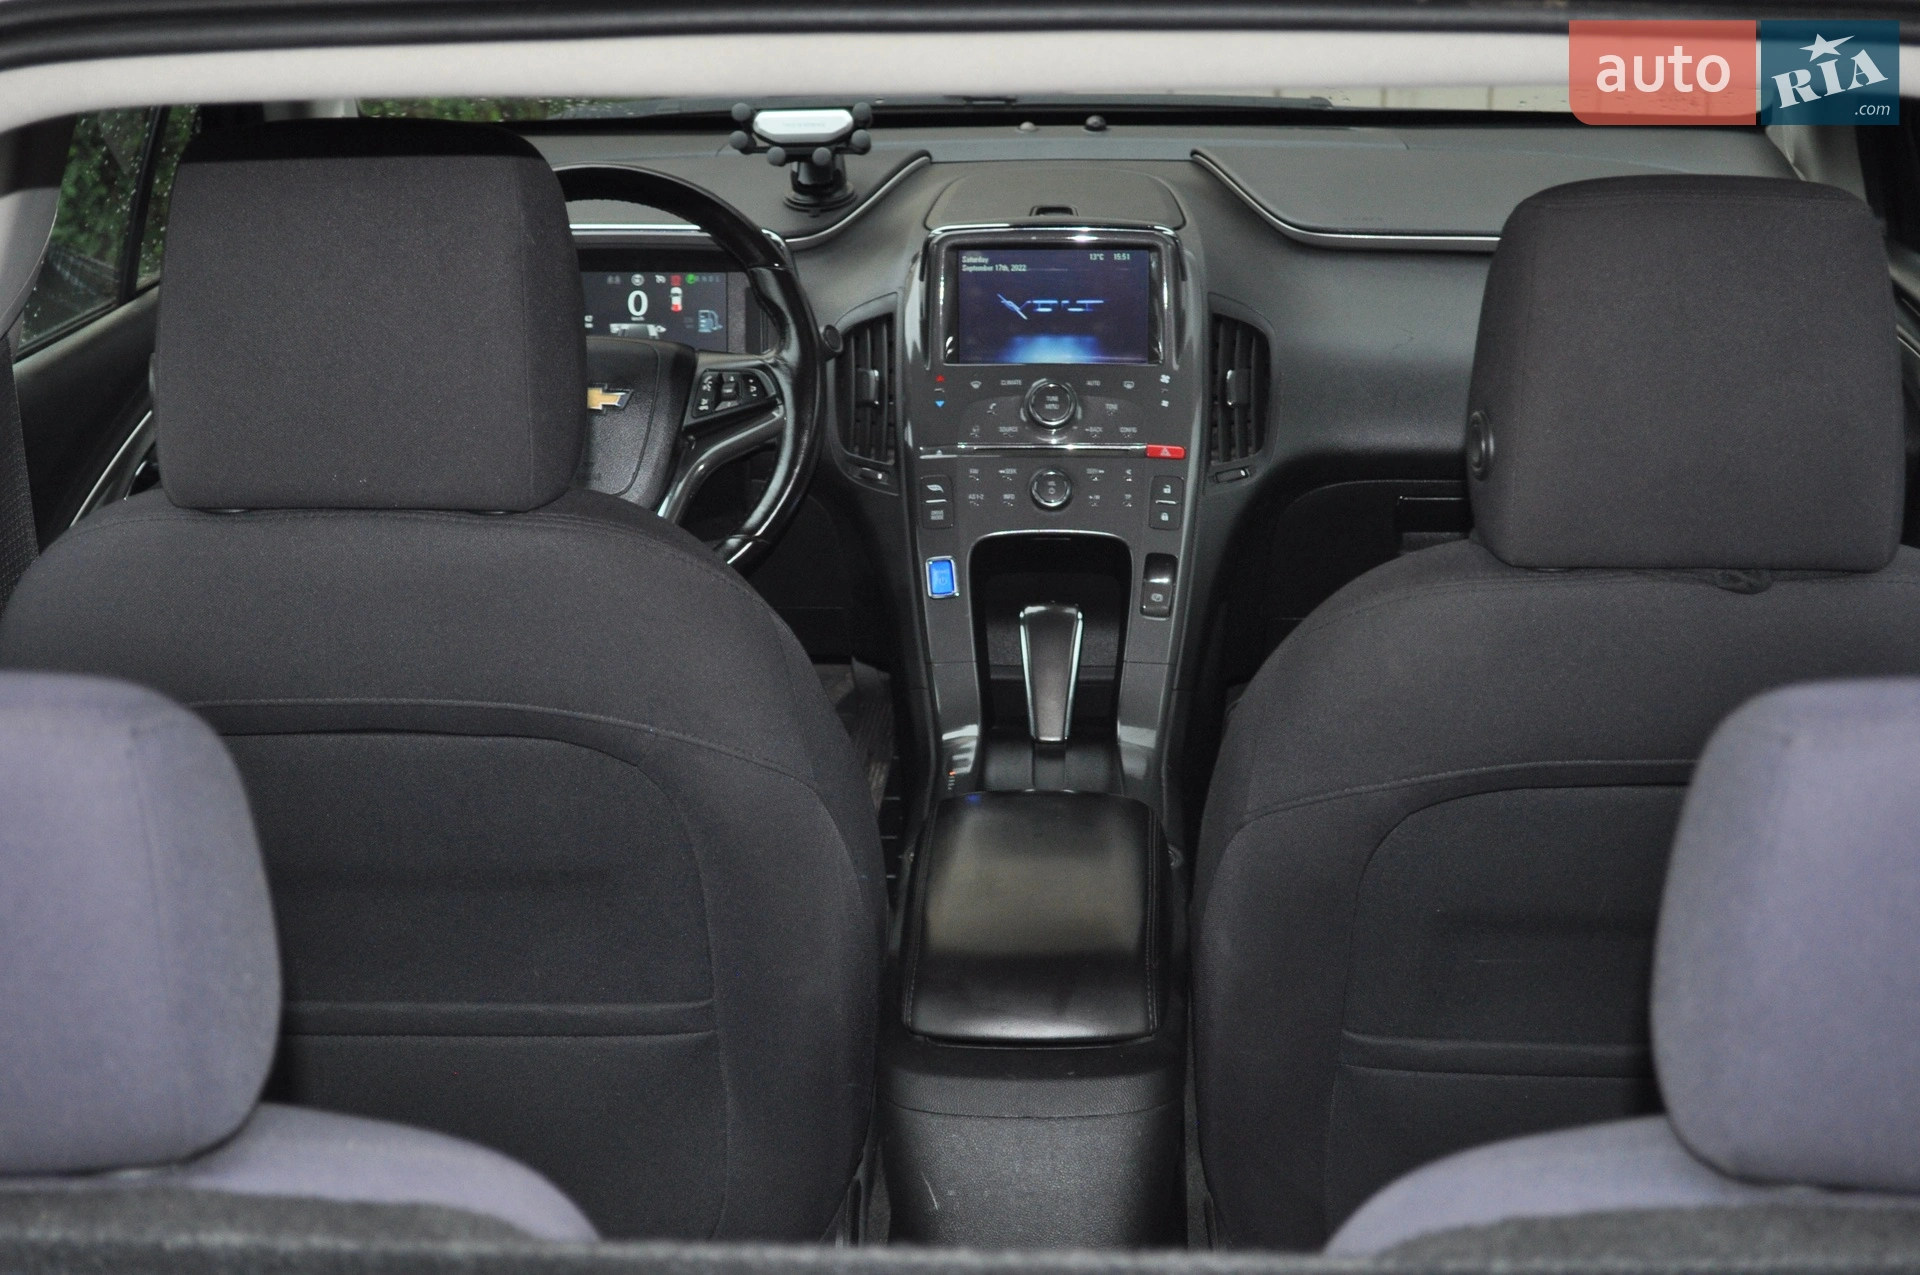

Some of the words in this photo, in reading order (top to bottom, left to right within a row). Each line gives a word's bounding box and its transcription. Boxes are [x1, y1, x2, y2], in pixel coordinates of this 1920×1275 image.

[961, 255, 989, 264] Saturday
[961, 264, 994, 272] September
[1010, 264, 1027, 272] 2022
[627, 290, 649, 317] 0
